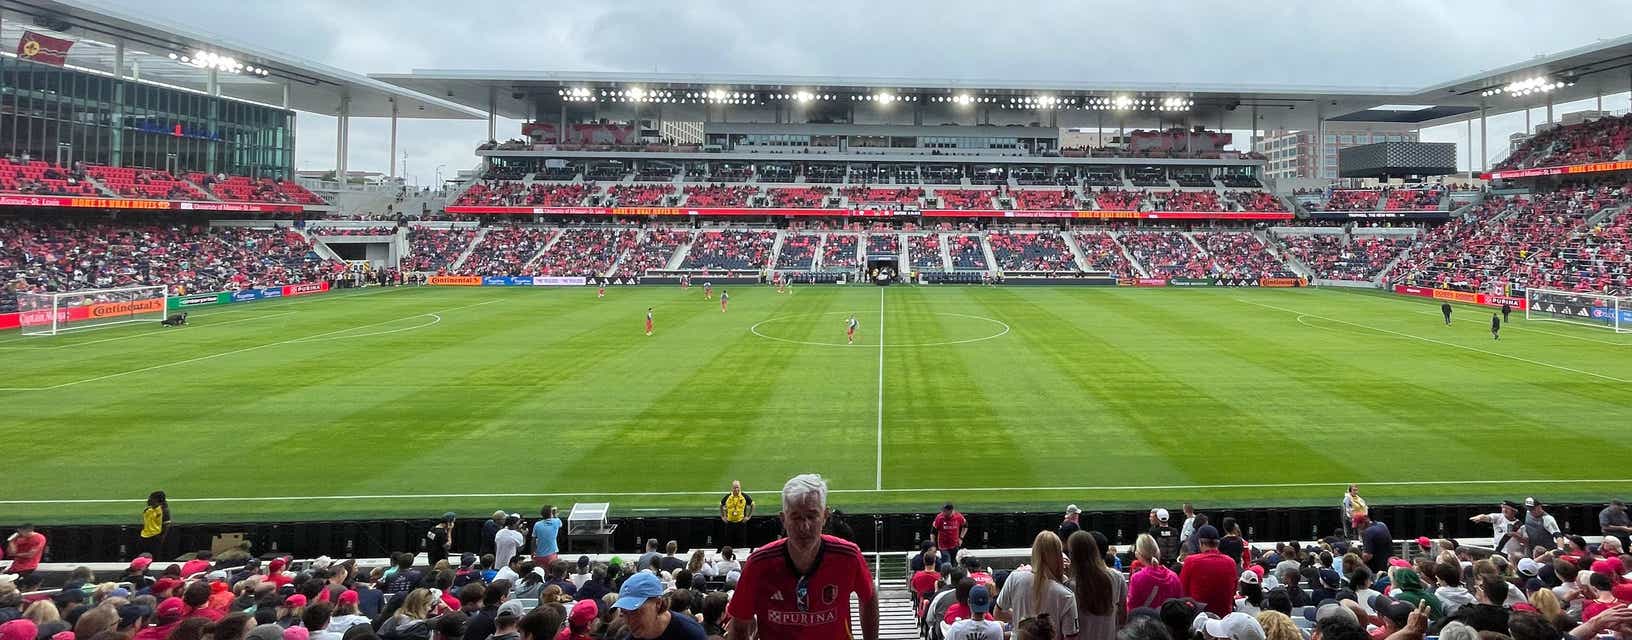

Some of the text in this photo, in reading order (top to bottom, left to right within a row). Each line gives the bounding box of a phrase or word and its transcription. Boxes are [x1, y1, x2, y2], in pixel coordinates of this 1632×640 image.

[93, 301, 153, 316] Continental
[1492, 297, 1519, 306] PURINA
[783, 611, 835, 625] PURINA
